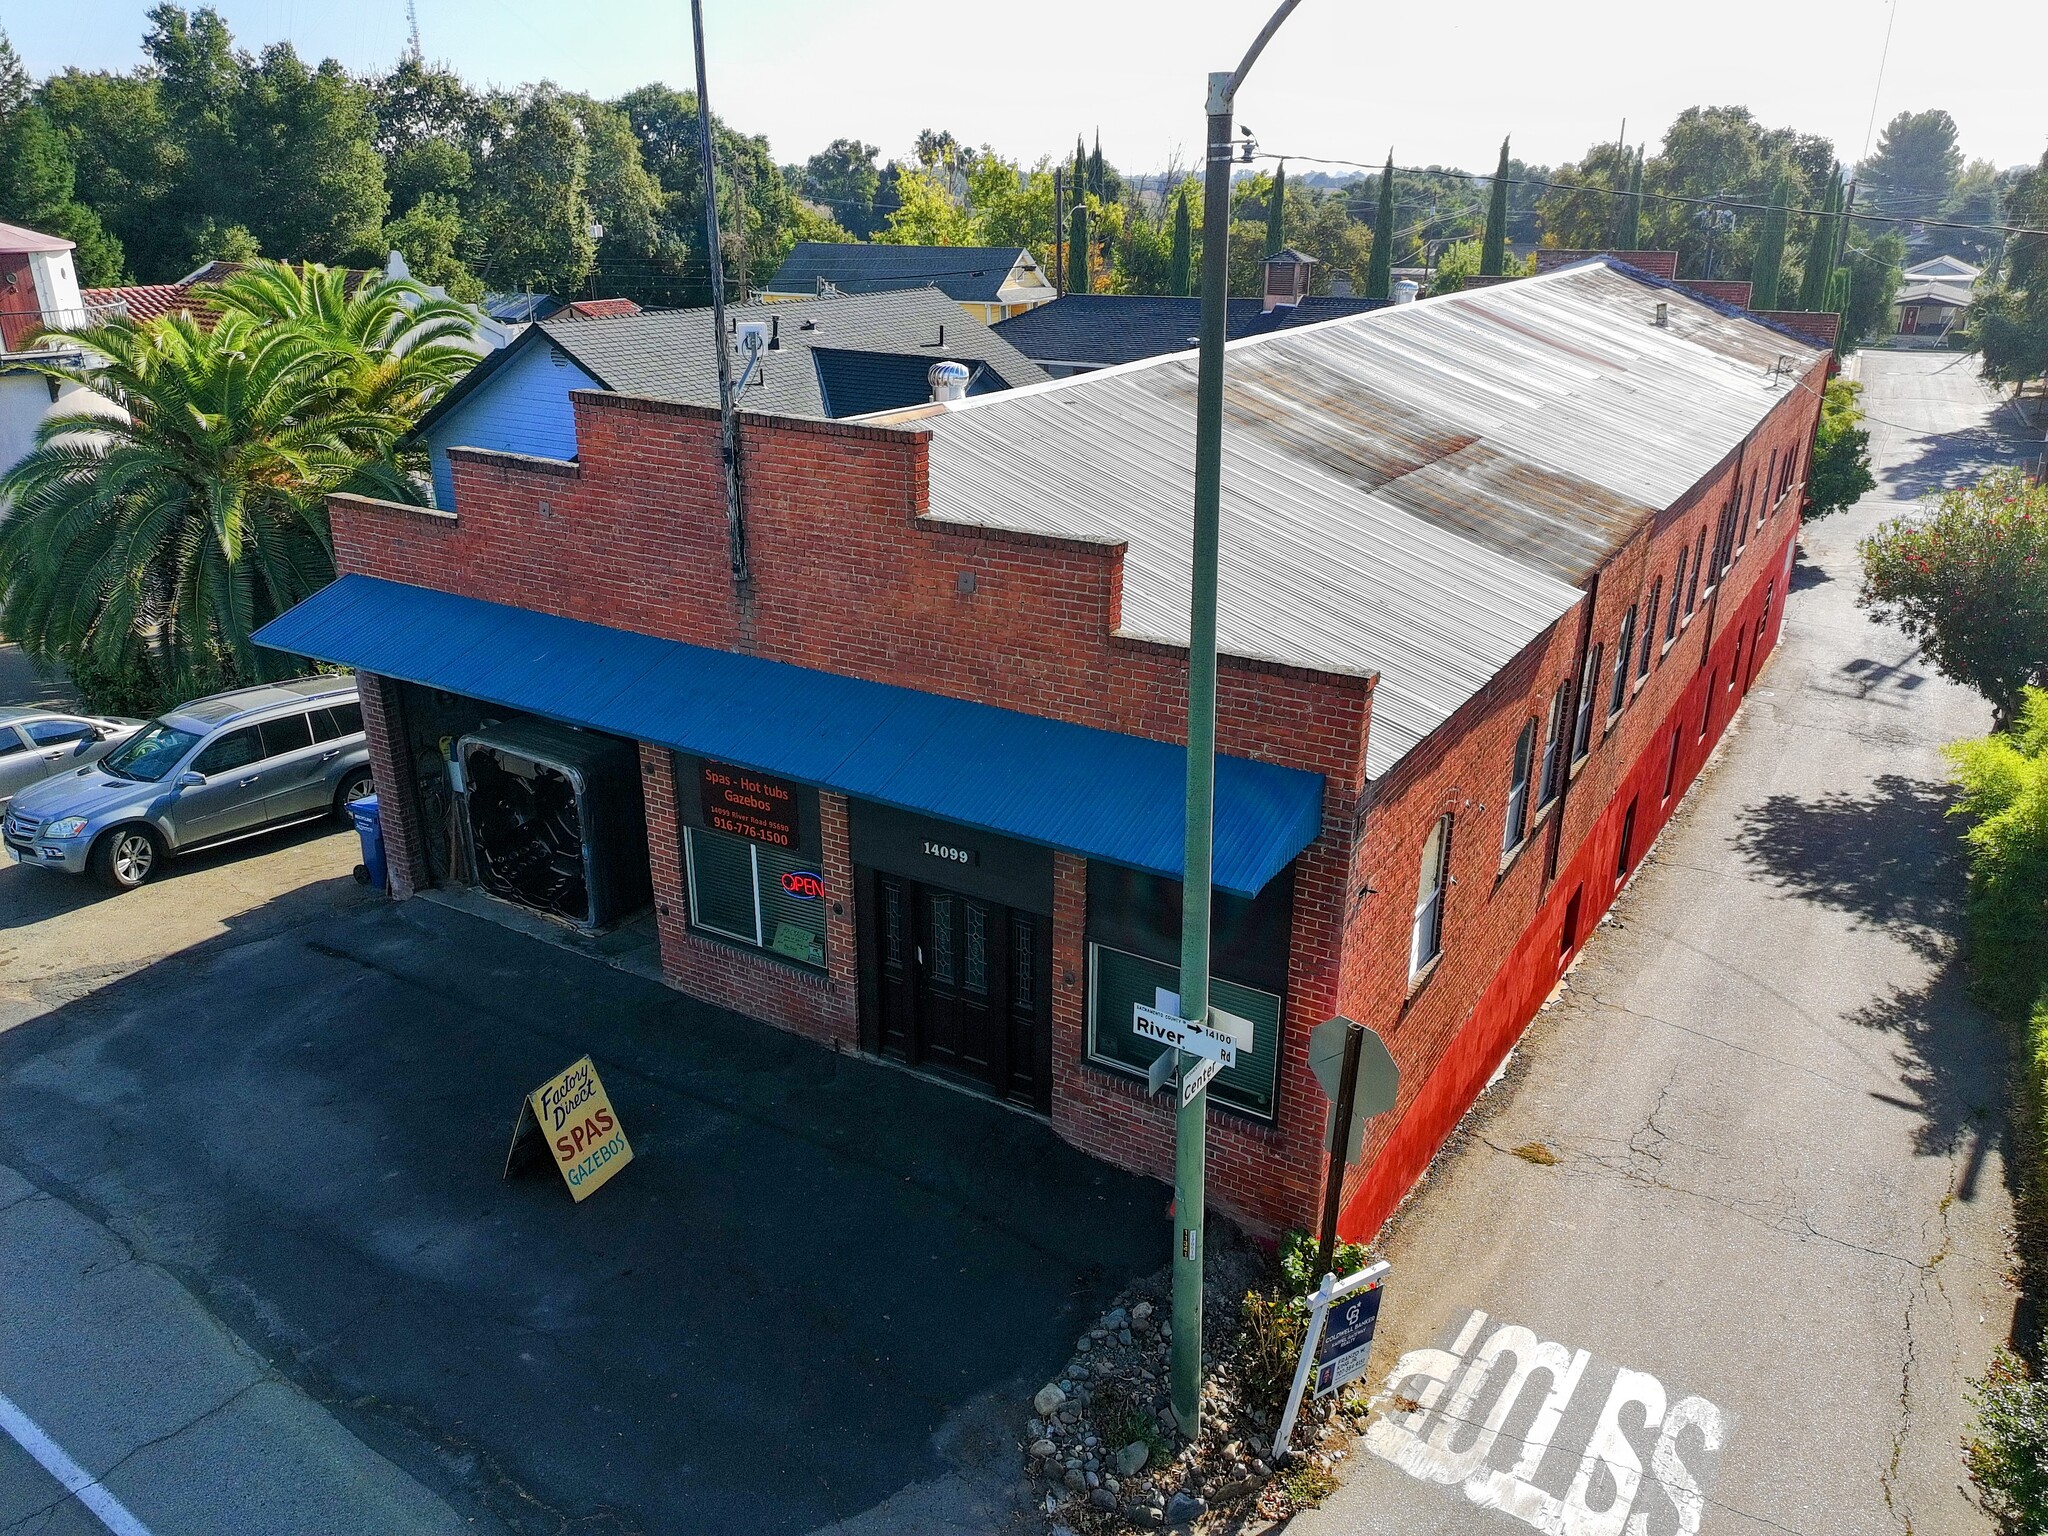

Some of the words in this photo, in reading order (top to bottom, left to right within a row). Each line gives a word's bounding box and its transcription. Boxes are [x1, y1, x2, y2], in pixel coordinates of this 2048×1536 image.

[705, 769, 731, 786] Spas
[741, 777, 762, 794] Hot
[764, 784, 789, 801] tubs
[724, 789, 771, 812] Gazebos
[711, 805, 730, 817] 14099
[732, 811, 749, 821] River
[751, 816, 767, 827] Road
[714, 817, 788, 846] 916-776-1500
[924, 842, 968, 863] 14099
[781, 873, 824, 898] OPEN
[1137, 1017, 1185, 1045] River
[1220, 1049, 1231, 1062] Rd
[1205, 1028, 1232, 1045] 14100
[540, 1064, 589, 1121] Factory
[1184, 1061, 1216, 1101] Center
[553, 1078, 597, 1132] Direct
[556, 1107, 614, 1162] SPAS
[568, 1131, 625, 1186] GAZEBOS
[1325, 1327, 1354, 1344] COLDWELL
[1354, 1315, 1376, 1330] BANKER
